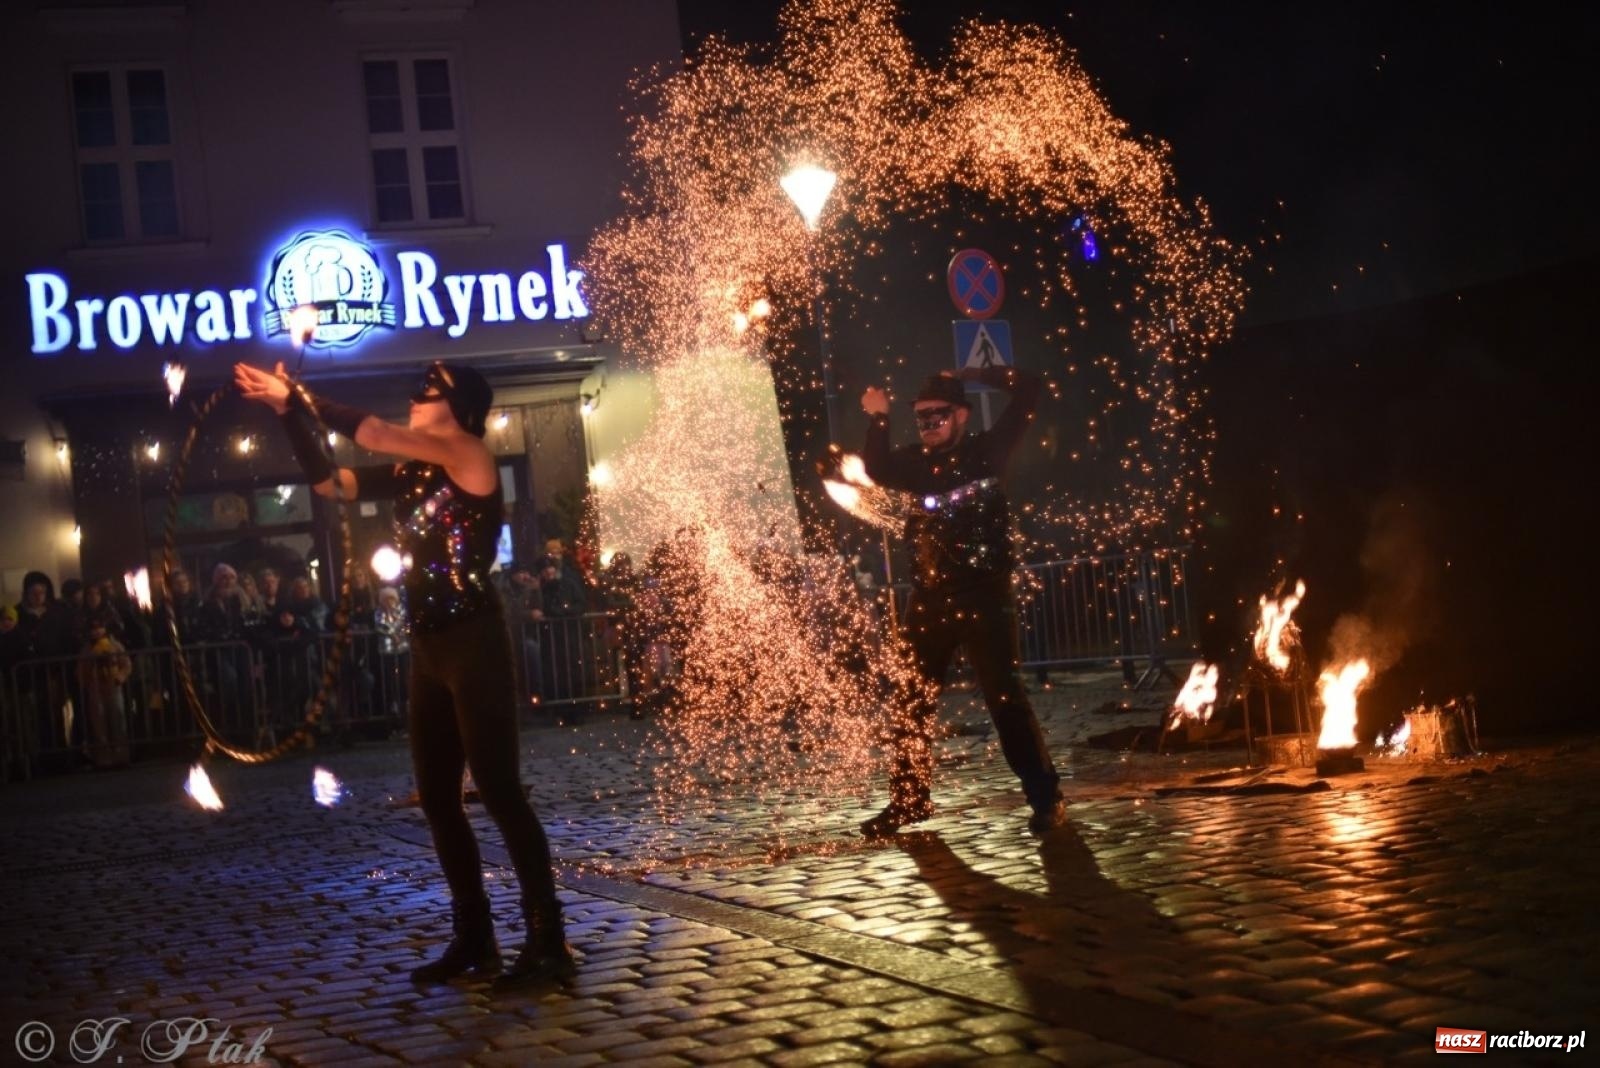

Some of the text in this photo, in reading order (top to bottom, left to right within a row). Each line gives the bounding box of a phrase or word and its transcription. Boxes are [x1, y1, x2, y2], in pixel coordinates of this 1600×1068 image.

[25, 244, 589, 354] Browar Rynek
[337, 302, 382, 325] Rynek
